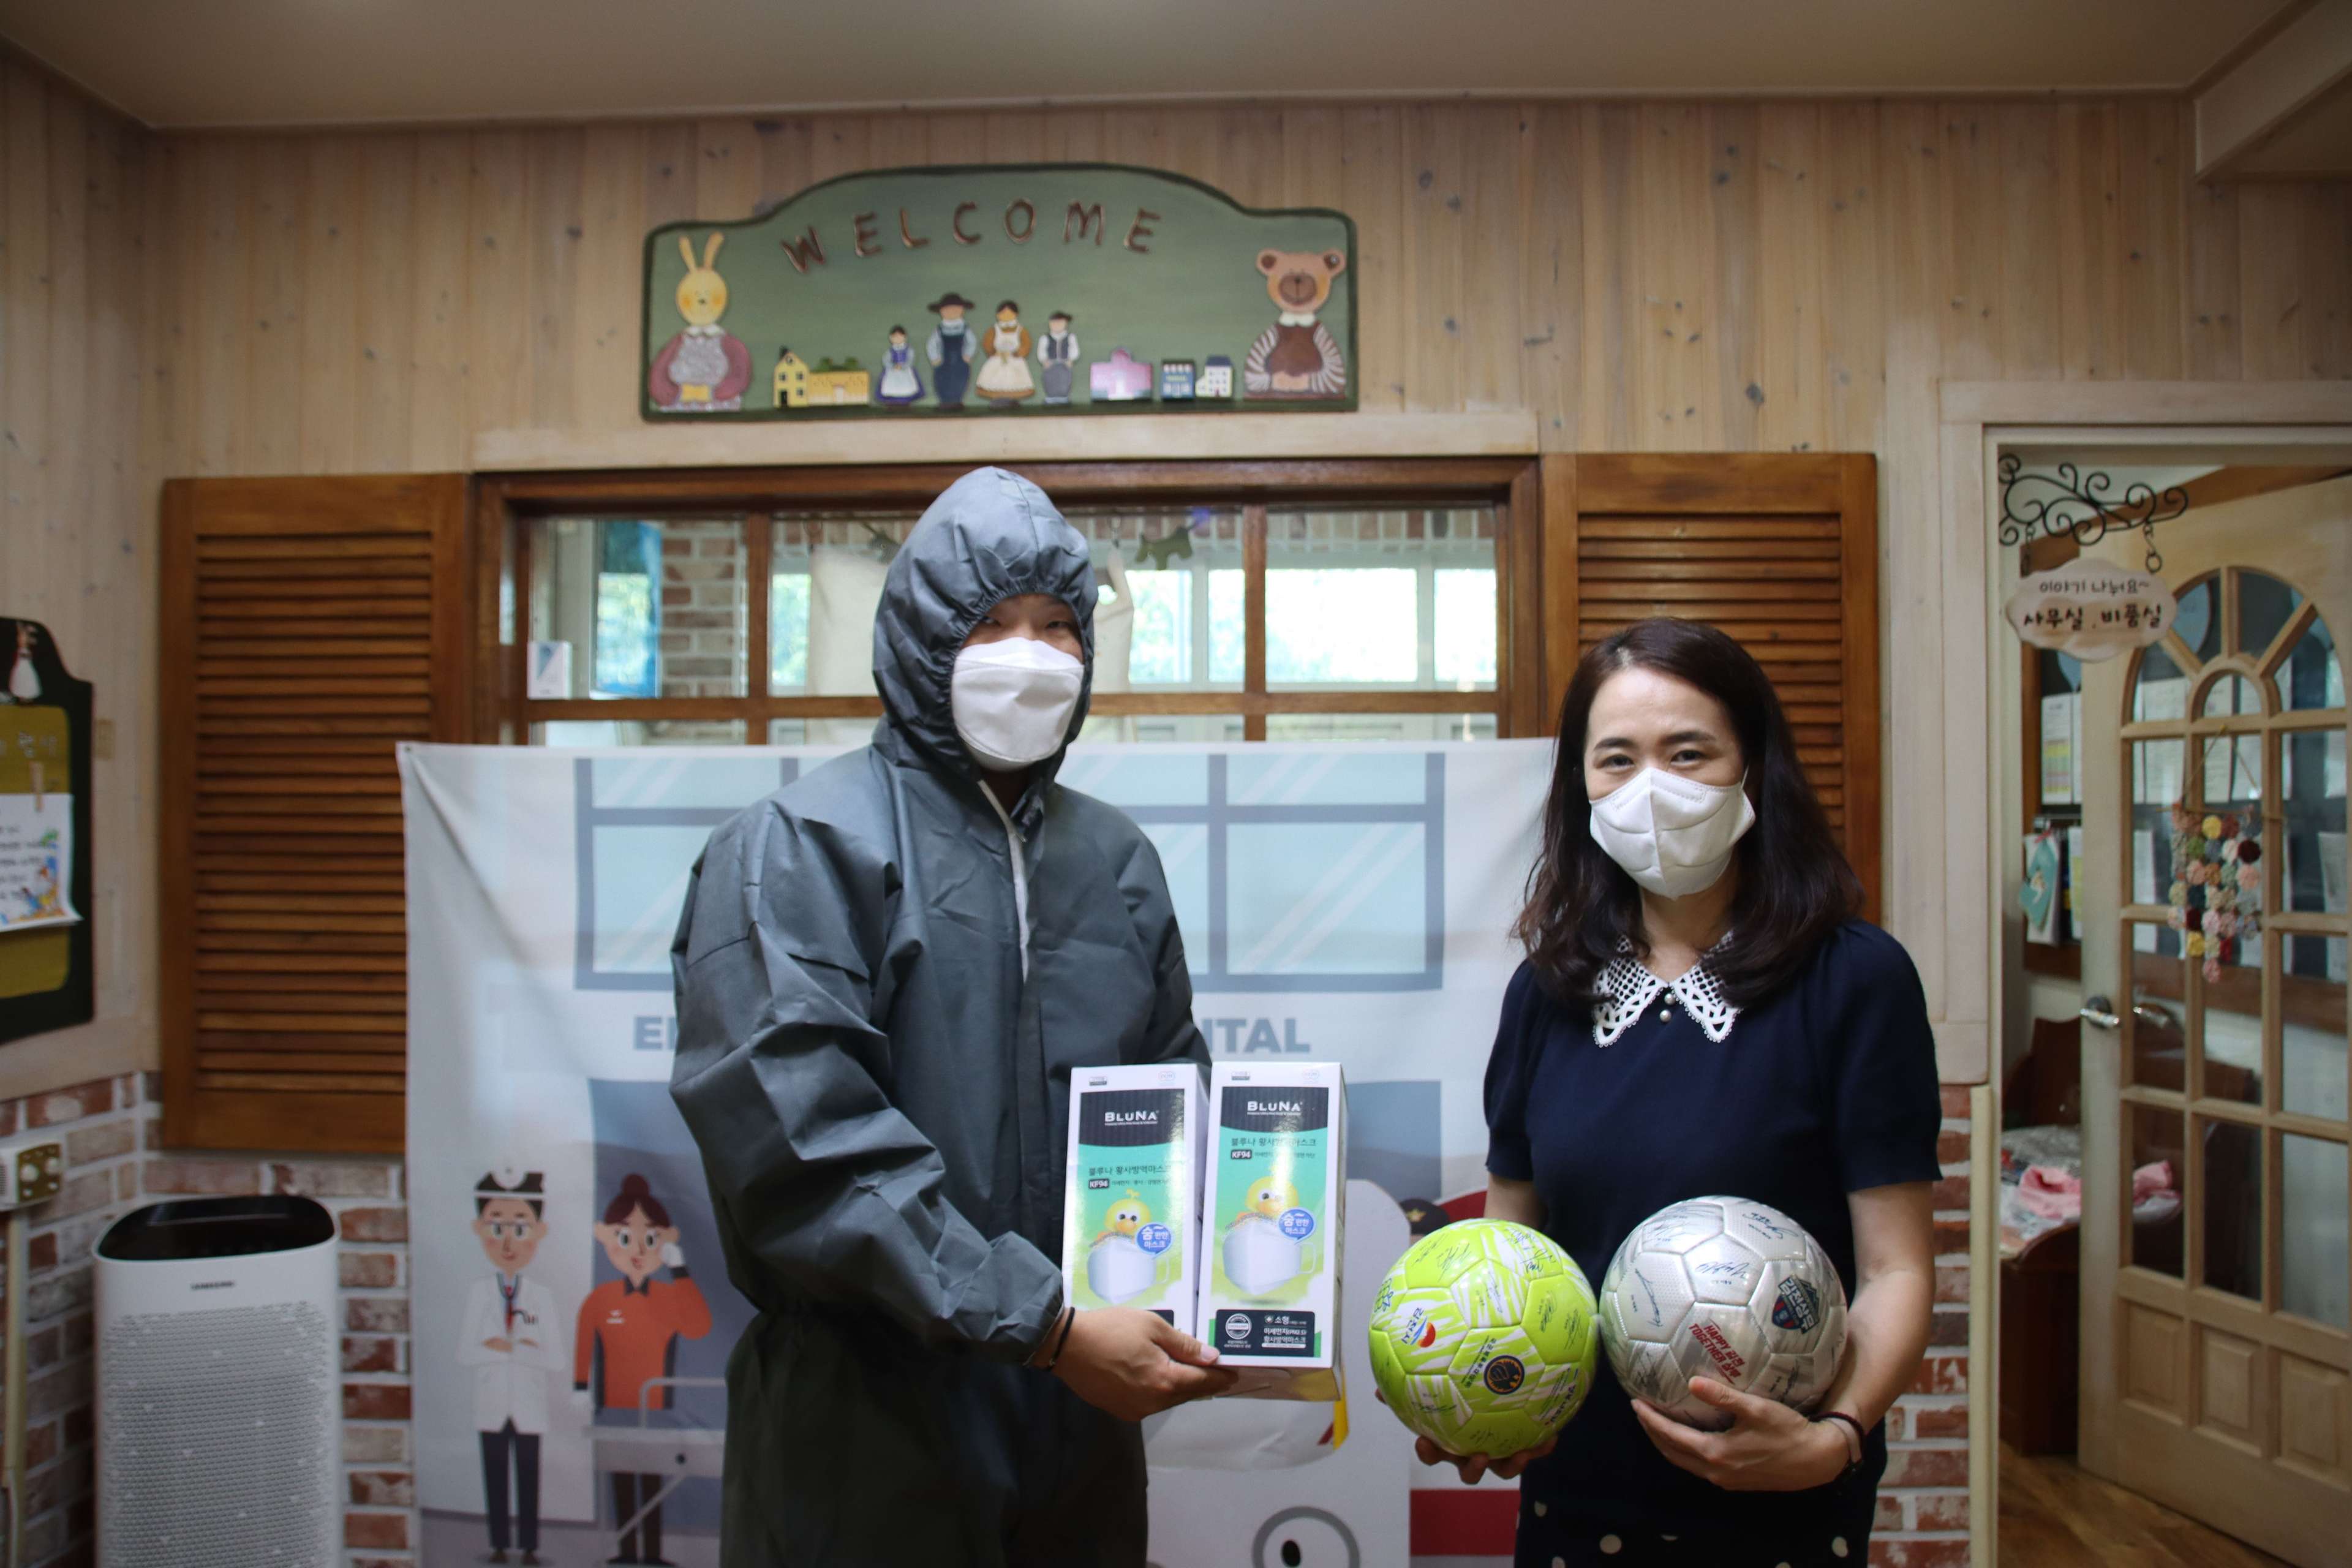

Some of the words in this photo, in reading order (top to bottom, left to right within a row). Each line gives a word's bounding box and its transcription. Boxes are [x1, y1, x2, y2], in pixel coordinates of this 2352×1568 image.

[780, 198, 1161, 273] WELCOME
[2040, 580, 2085, 594] 이야기
[2101, 603, 2161, 628] 비품실
[1090, 1180, 1108, 1188] KF94
[1688, 1323, 1727, 1363] TOGETHER
[1704, 1324, 1732, 1349] HAPPY
